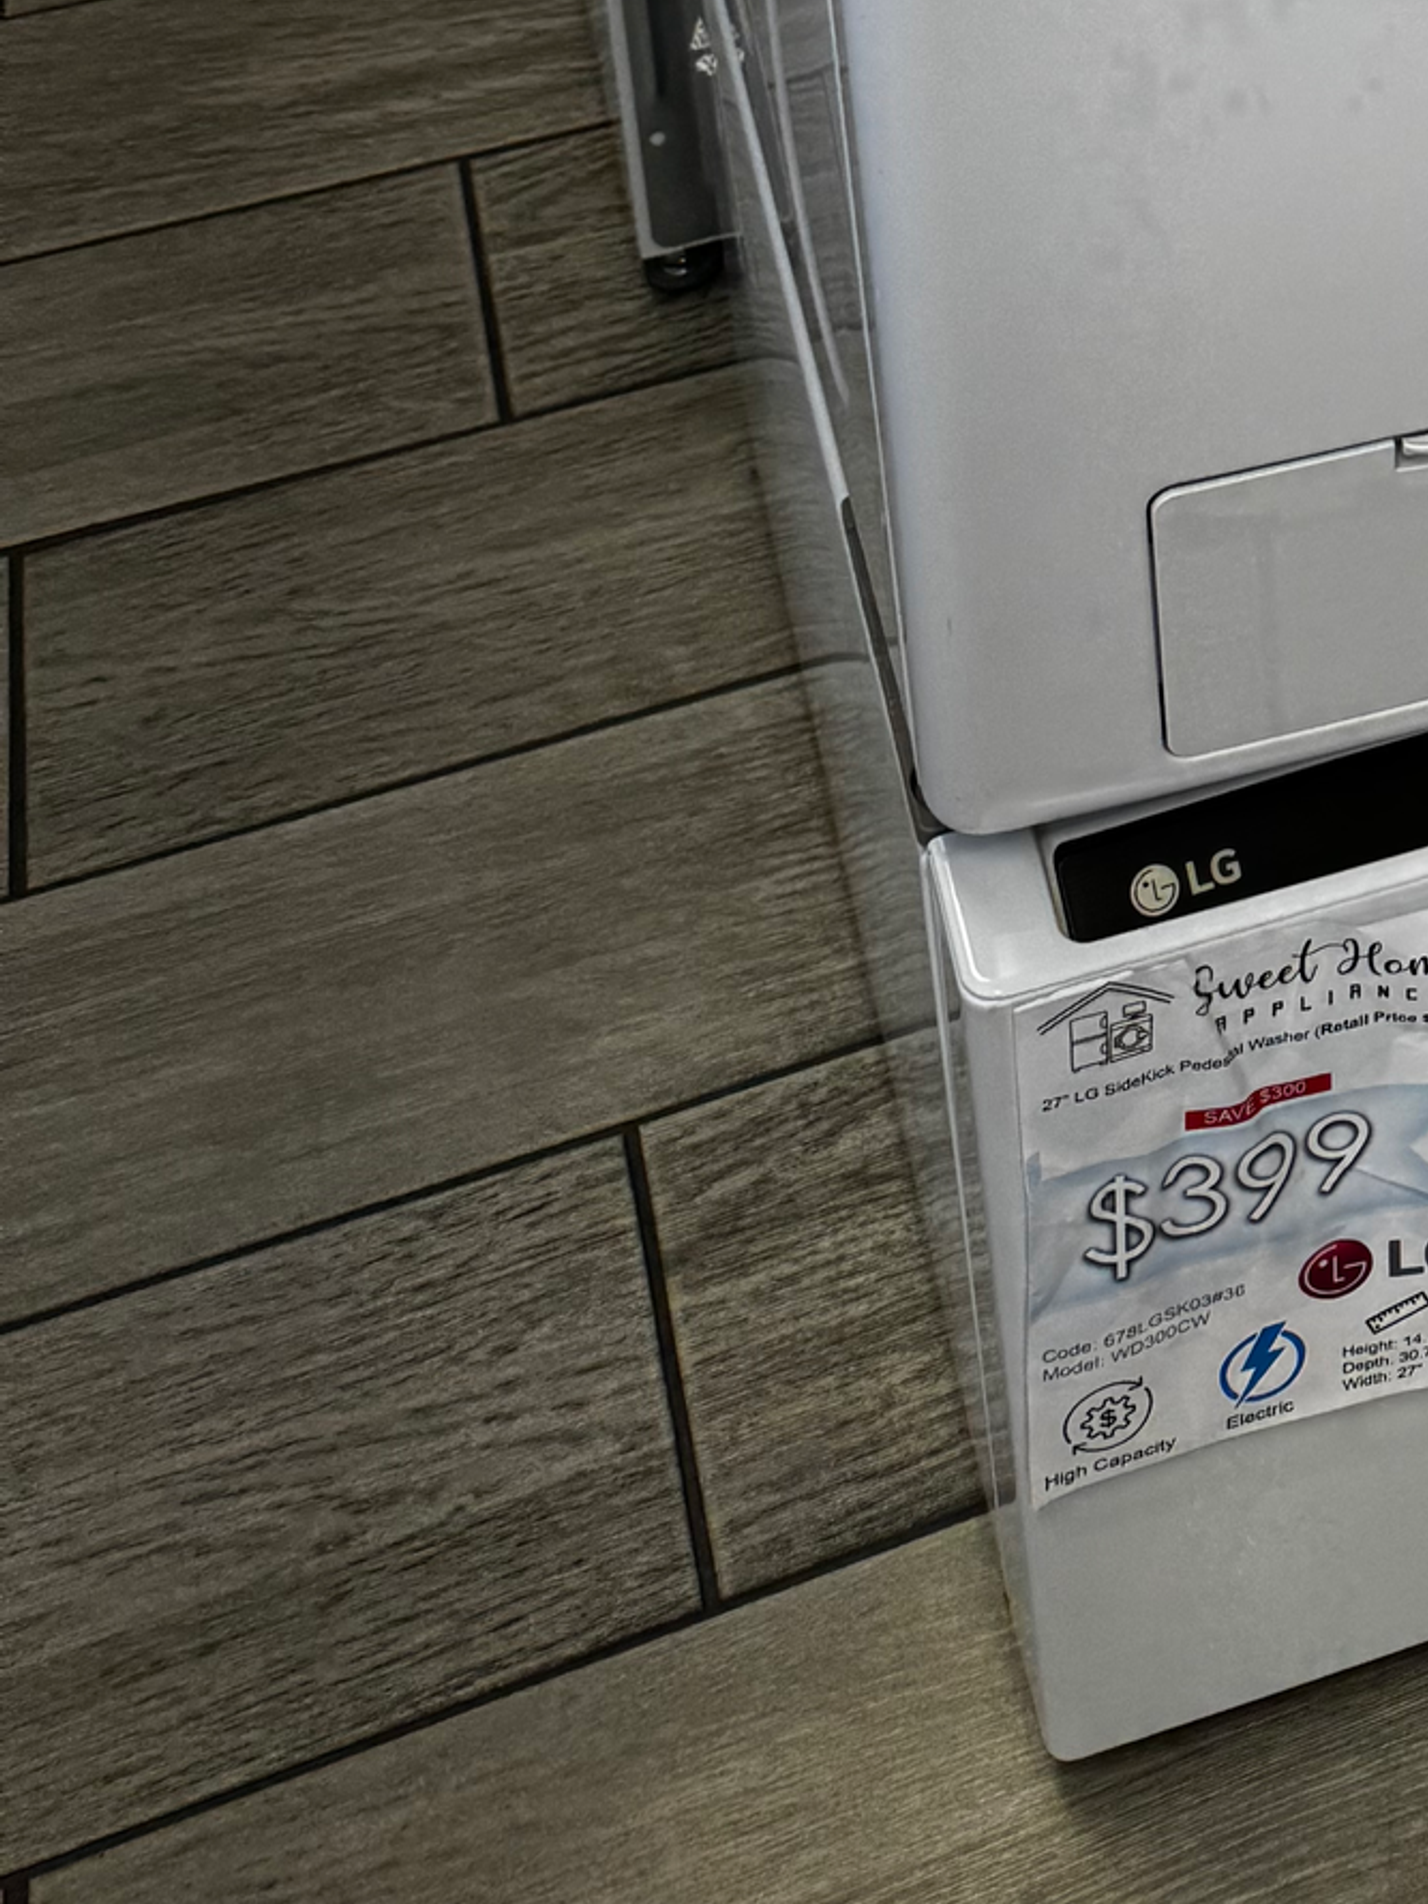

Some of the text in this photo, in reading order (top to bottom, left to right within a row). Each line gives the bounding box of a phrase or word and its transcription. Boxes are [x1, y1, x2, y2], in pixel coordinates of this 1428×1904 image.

[1185, 846, 1243, 898] LG
[1193, 938, 1318, 1017] Sweet
[1074, 1086, 1100, 1104] LG
[1104, 1064, 1176, 1097] SideKick
[1249, 1028, 1310, 1052] Washer
[1313, 1014, 1370, 1041] (Retail
[1373, 1010, 1418, 1026] Price
[1202, 1078, 1307, 1125] SAVE $300
[1082, 1108, 1375, 1283] $399
[1042, 1341, 1098, 1364] Code:
[1042, 1356, 1105, 1382] Model:
[1342, 1338, 1398, 1359] Height:
[1341, 1372, 1392, 1391] Width:
[1225, 1400, 1295, 1430] Electric
[1044, 1436, 1178, 1493] High Capacity
